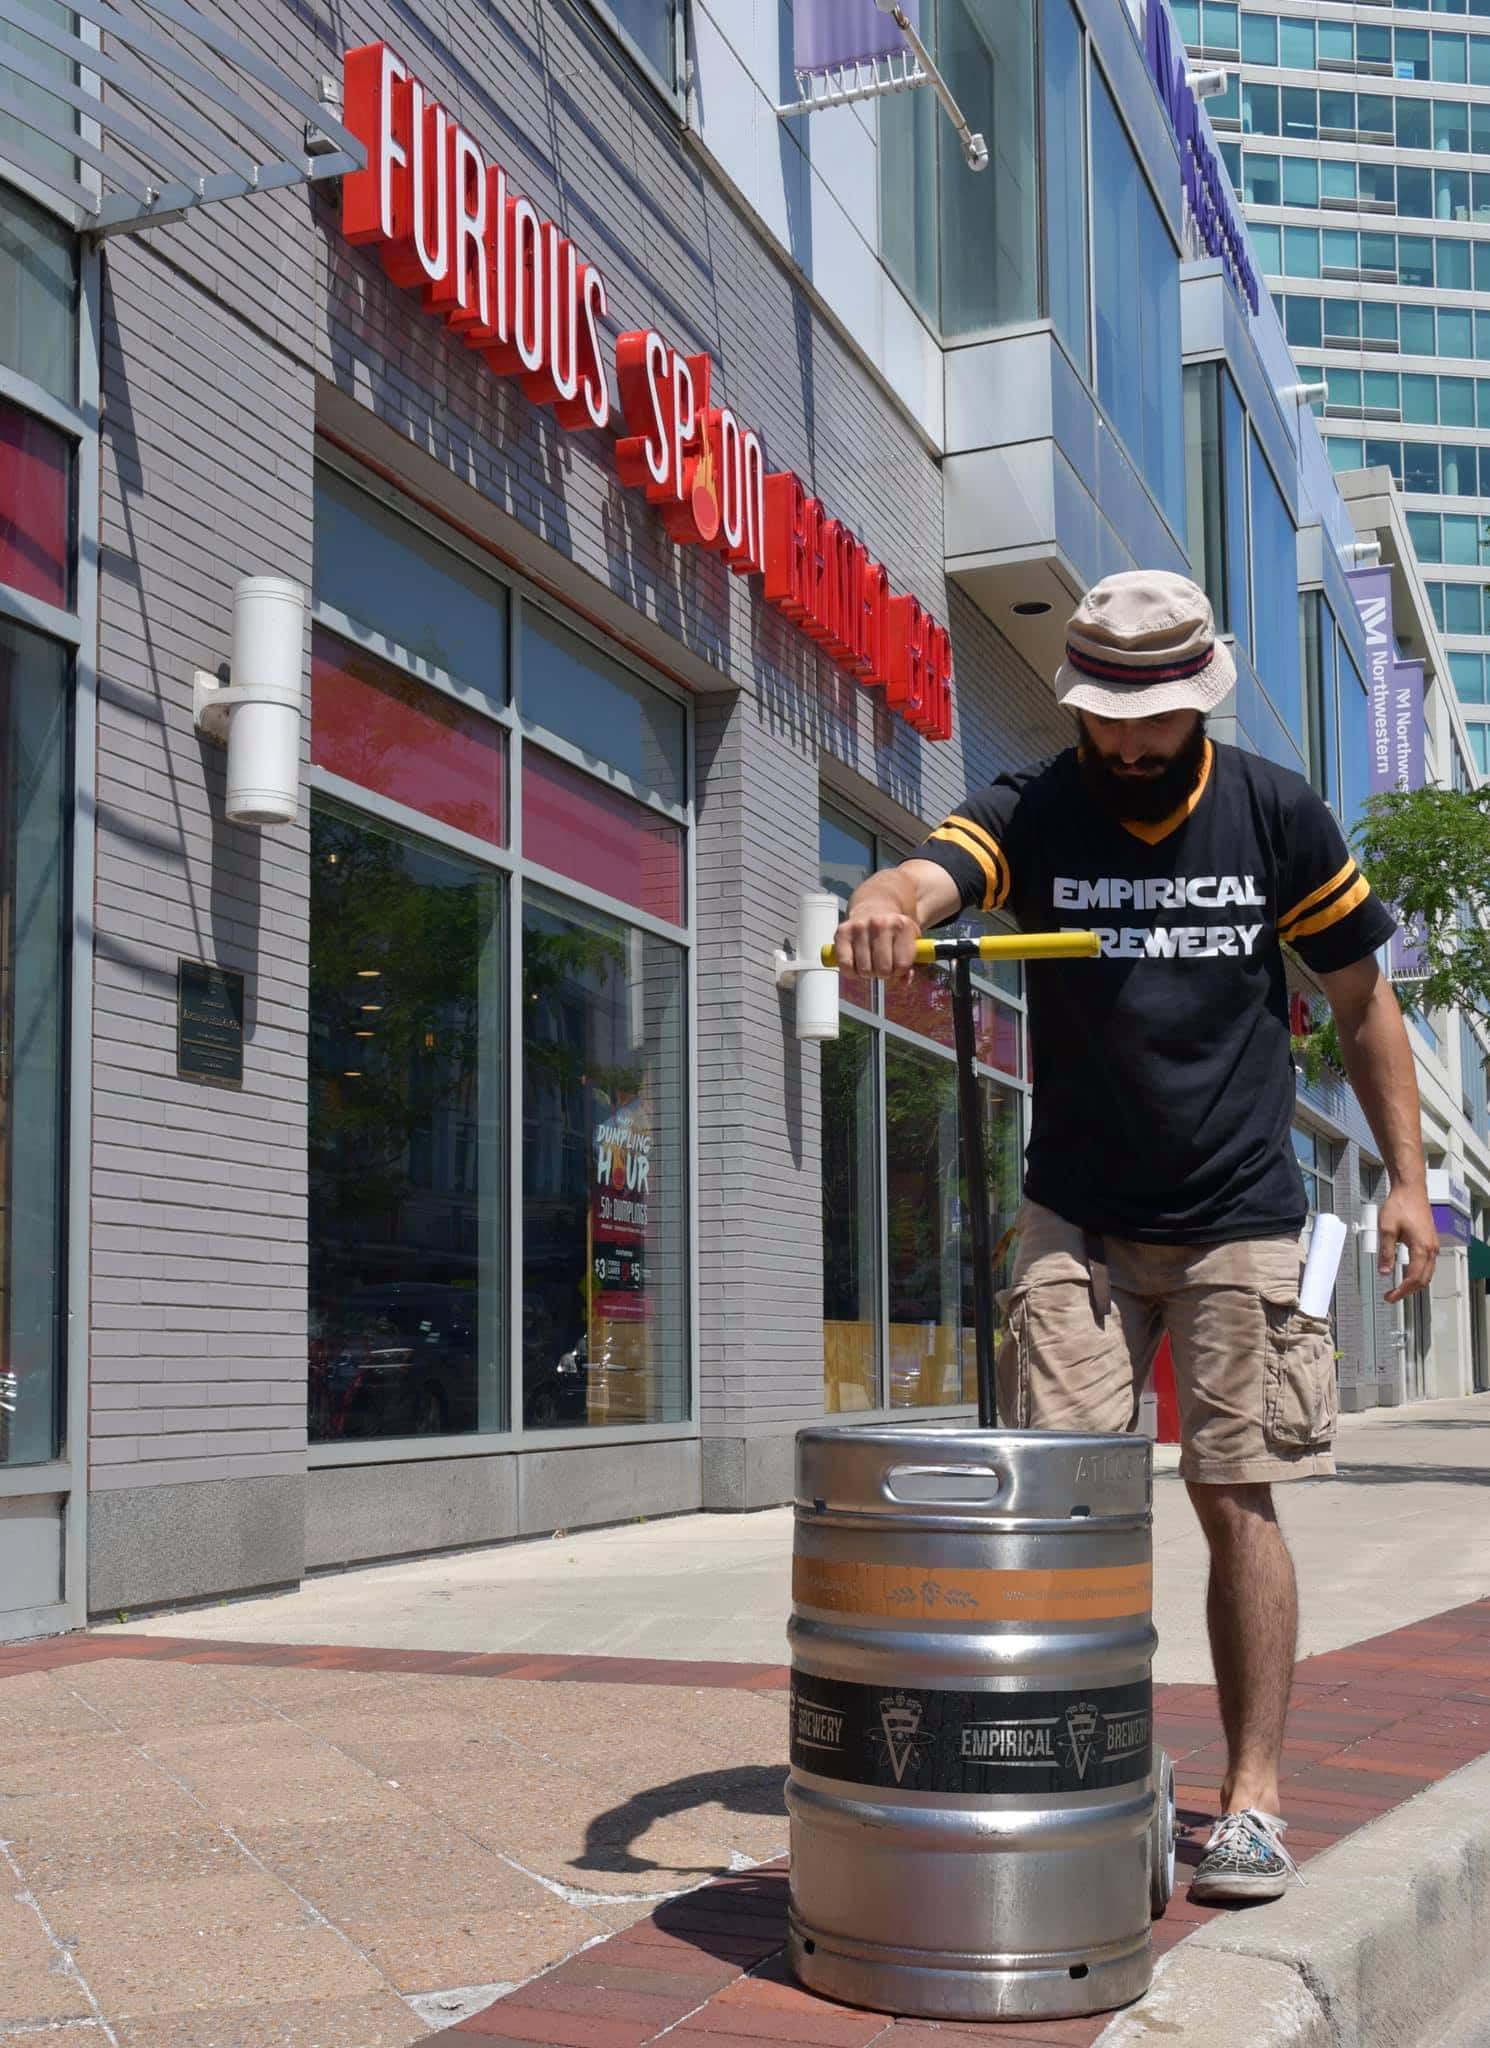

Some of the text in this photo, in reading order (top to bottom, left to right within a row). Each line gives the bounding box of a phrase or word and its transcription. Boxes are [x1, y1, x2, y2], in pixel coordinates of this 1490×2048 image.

[366, 42, 609, 430] FURIOUS
[1371, 651, 1390, 774] Northwestern
[1053, 875, 1266, 910] EMPIRICAL
[1060, 924, 1264, 958] REWERY
[960, 1726, 1056, 1757] EMPIRICAL
